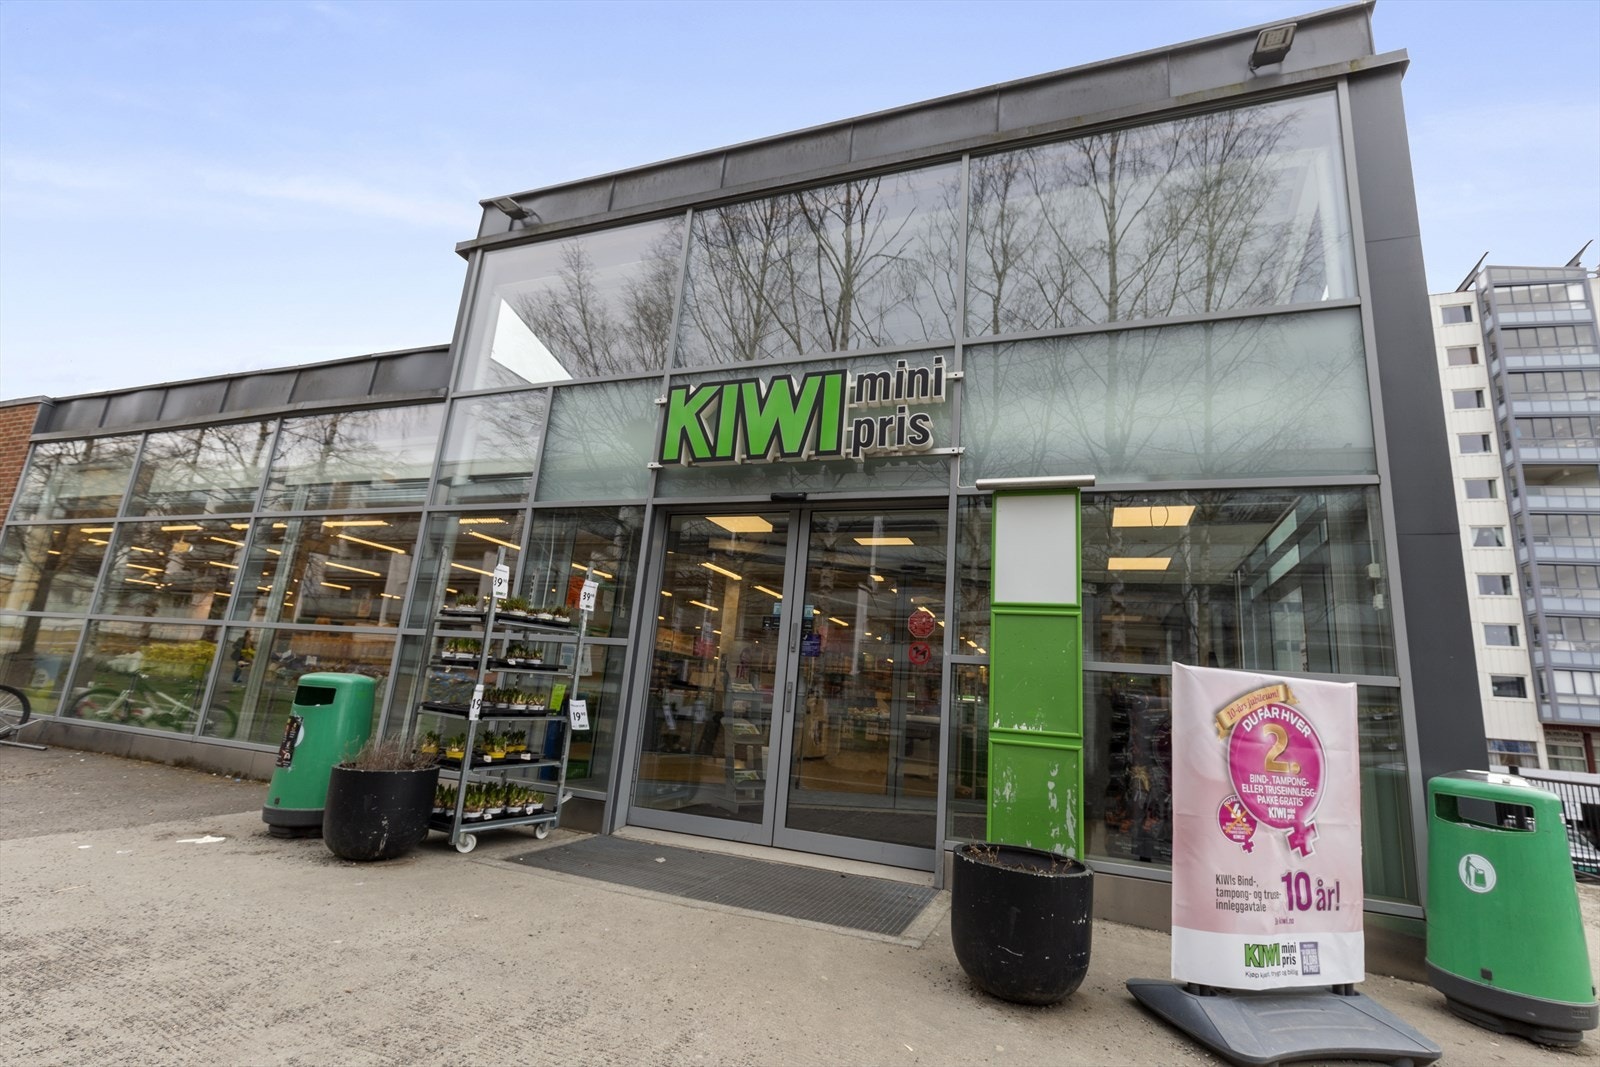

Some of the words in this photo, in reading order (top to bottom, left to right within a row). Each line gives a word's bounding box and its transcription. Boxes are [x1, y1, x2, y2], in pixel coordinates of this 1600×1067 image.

[659, 369, 849, 465] KIWI
[855, 356, 944, 404] mini
[852, 405, 932, 459] pris
[573, 711, 581, 721] 19
[1242, 713, 1259, 732] DU
[1258, 705, 1280, 720] FÅR
[1281, 709, 1312, 738] HVER
[1262, 723, 1301, 776] 2.
[1242, 784, 1264, 794] ELLER
[1265, 785, 1317, 797] TRUSEINNLEGG-
[1257, 795, 1278, 805] PAKKE
[1279, 796, 1304, 807] GRATIS
[1268, 807, 1287, 819] KIWI
[1215, 874, 1236, 886] KIWIs
[1216, 888, 1252, 900] tampong-
[1253, 891, 1262, 900] og
[1281, 871, 1312, 912] 10
[1316, 879, 1340, 912] år!
[1215, 899, 1267, 914] innleggavtale
[1244, 943, 1281, 968] KIWI
[1281, 942, 1297, 954] mini
[1281, 954, 1297, 968] pris
